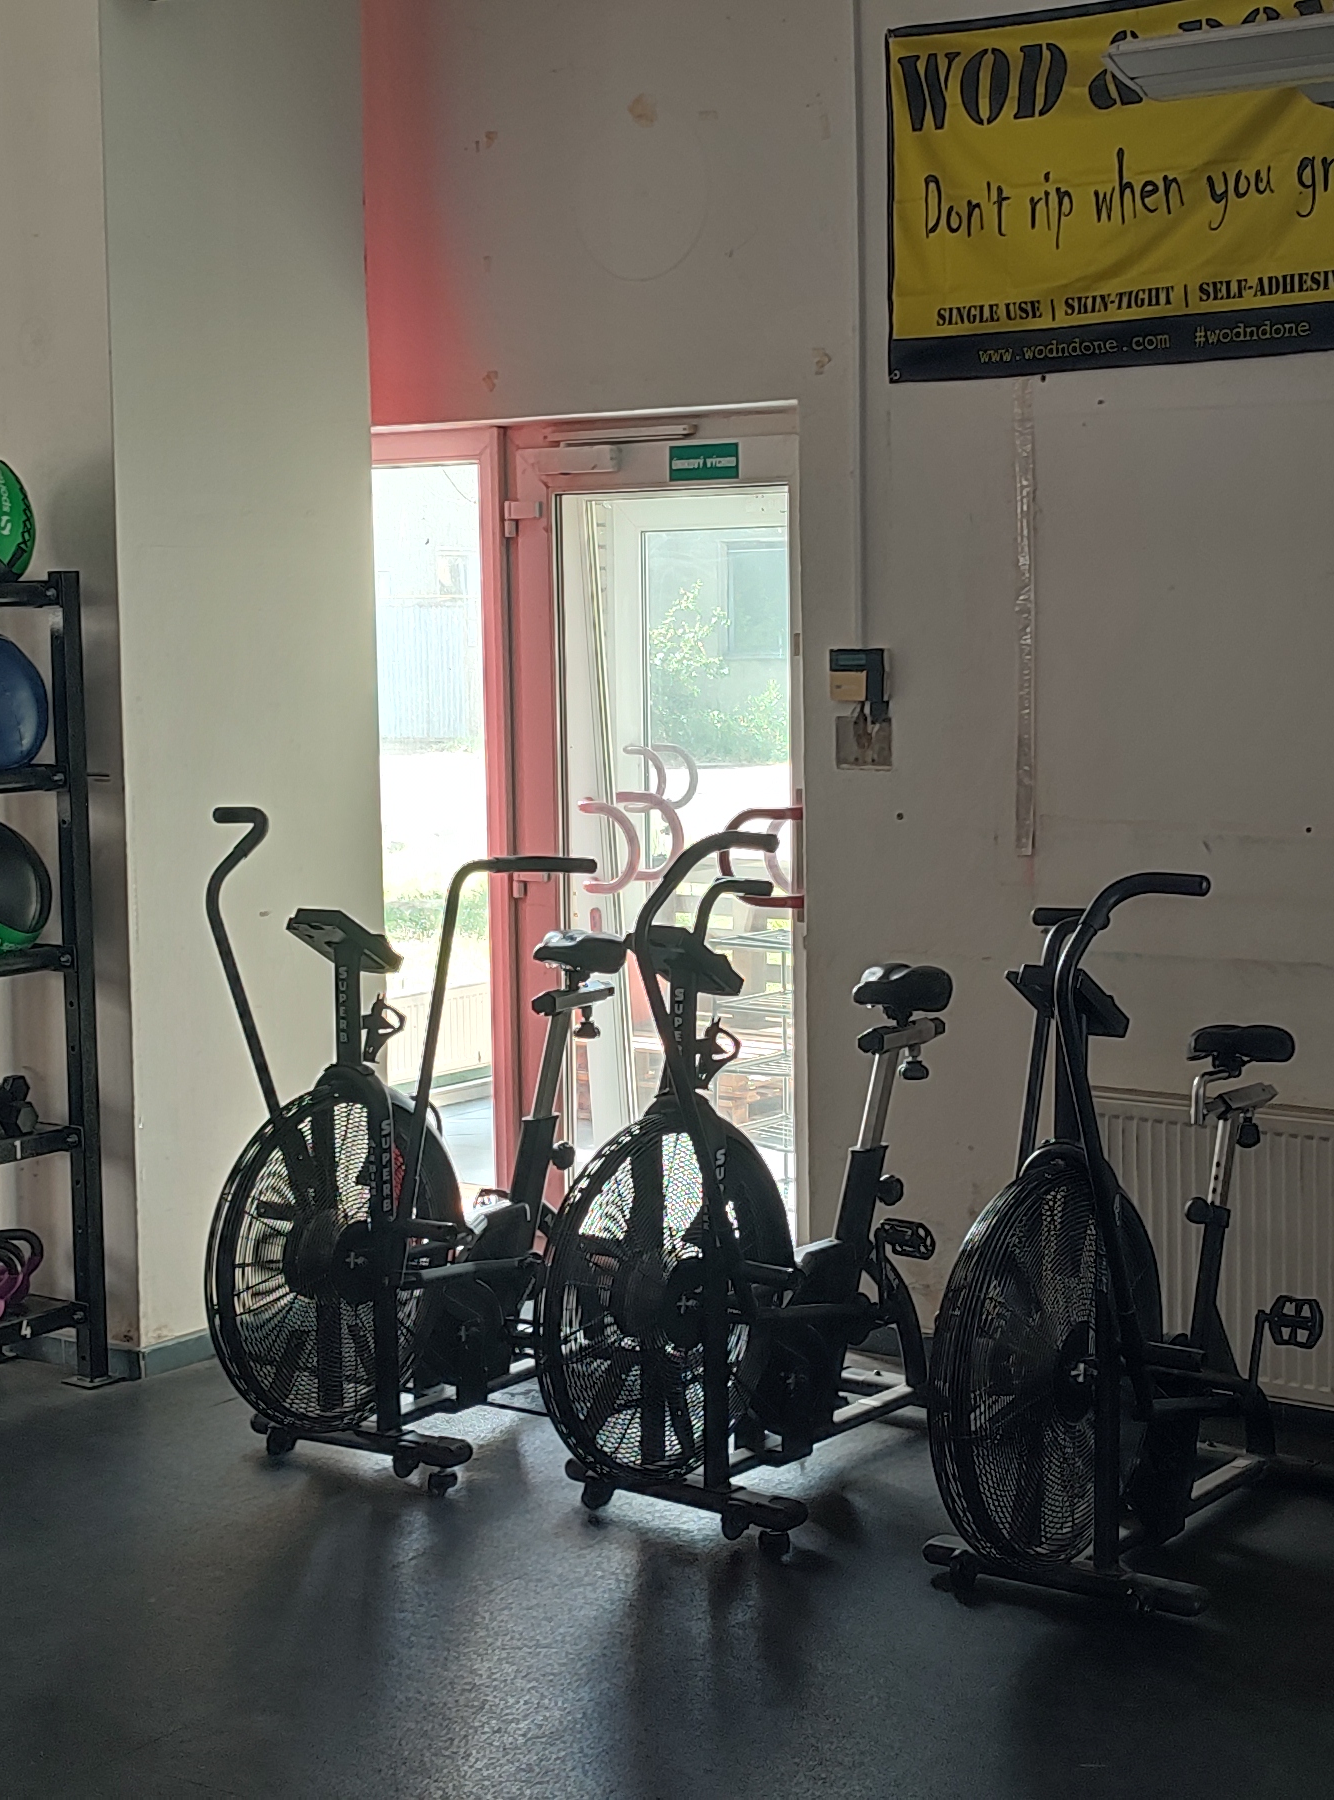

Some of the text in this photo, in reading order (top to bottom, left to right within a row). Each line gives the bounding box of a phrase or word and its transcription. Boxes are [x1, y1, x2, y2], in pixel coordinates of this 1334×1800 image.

[898, 42, 1067, 132] WOD
[923, 174, 1012, 239] Don't
[1029, 171, 1074, 250] rip
[1094, 147, 1185, 225] when
[1206, 165, 1275, 231] you
[936, 302, 1000, 327] SINGLE
[1005, 299, 1043, 322] USE
[1064, 285, 1174, 317] SKIN-TIGHT
[978, 320, 1311, 364] www.wodndone.com #wodndone
[338, 966, 348, 1042] SUPERB
[13, 1140, 22, 1159] 1
[381, 1119, 392, 1212] SUPERB
[20, 1319, 32, 1338] 4
